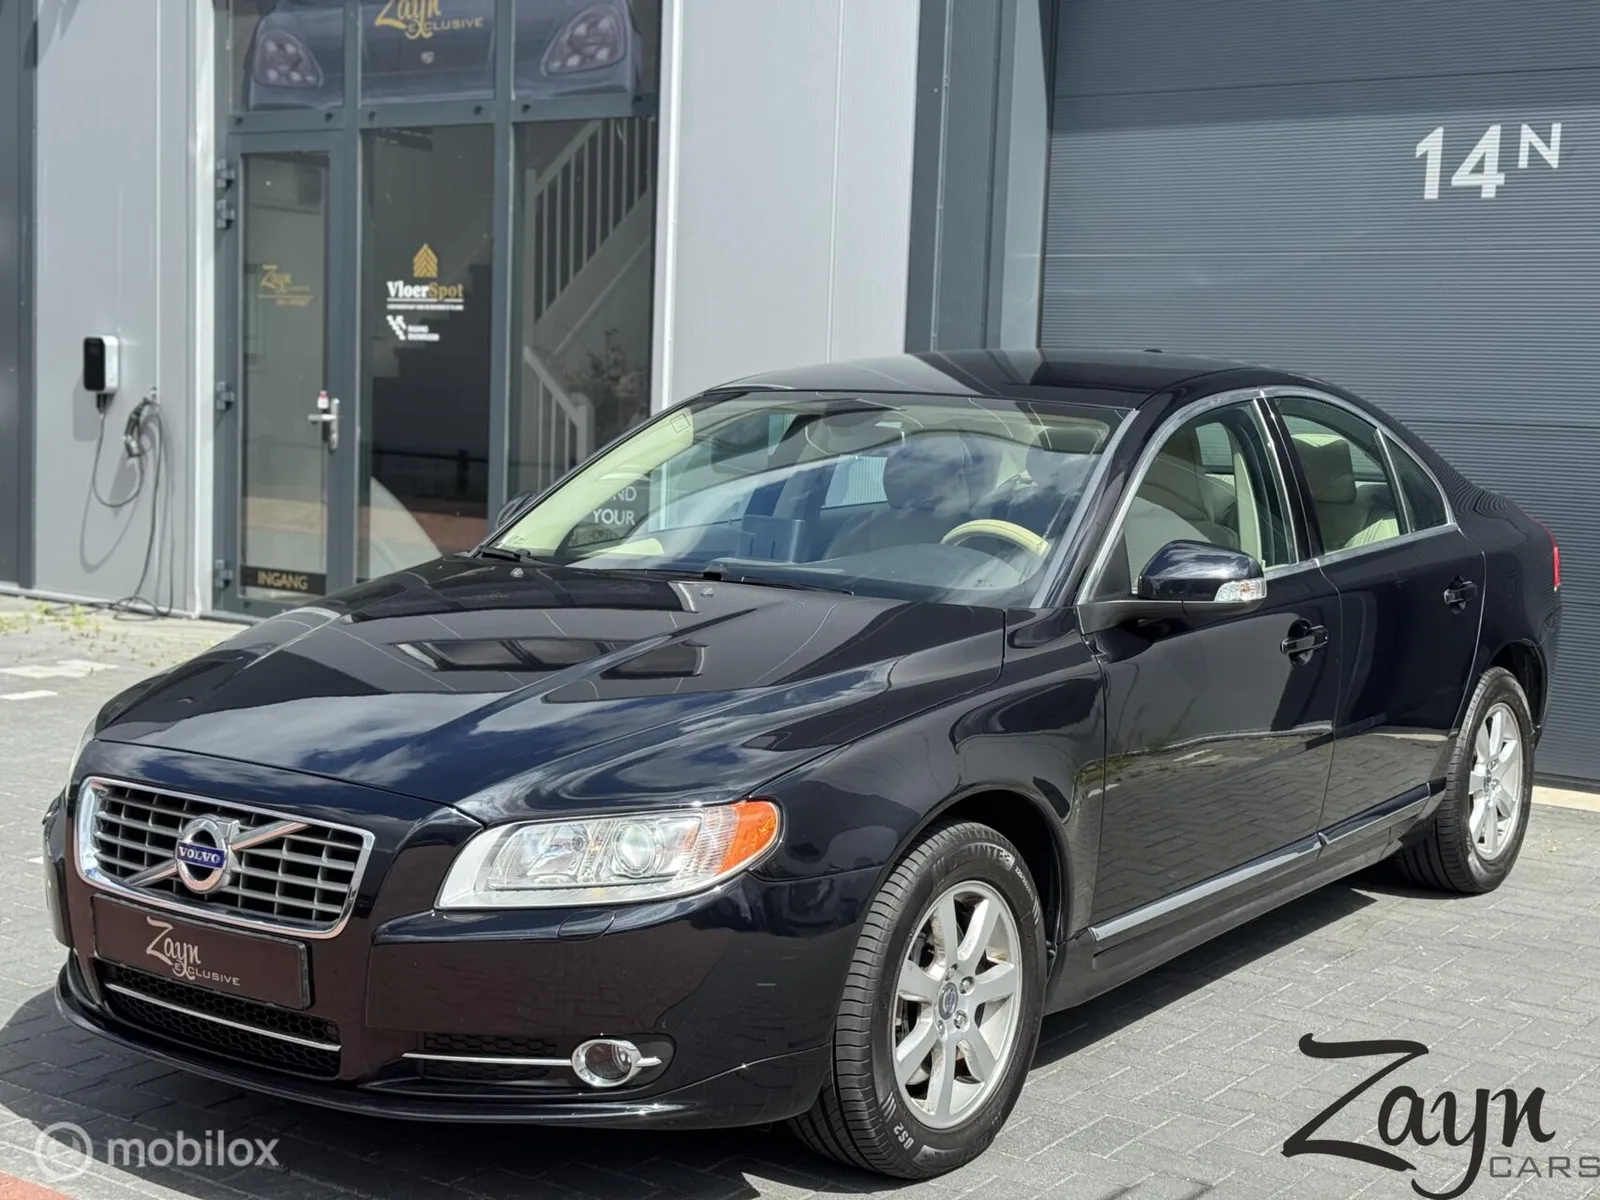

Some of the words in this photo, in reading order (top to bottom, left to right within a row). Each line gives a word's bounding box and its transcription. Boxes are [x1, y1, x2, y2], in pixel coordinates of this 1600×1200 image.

[386, 280, 463, 301] VloerSpot
[593, 508, 636, 525] YOUR
[257, 571, 309, 591] INGANG
[179, 846, 221, 864] VOLVO
[146, 916, 202, 980] Zayn
